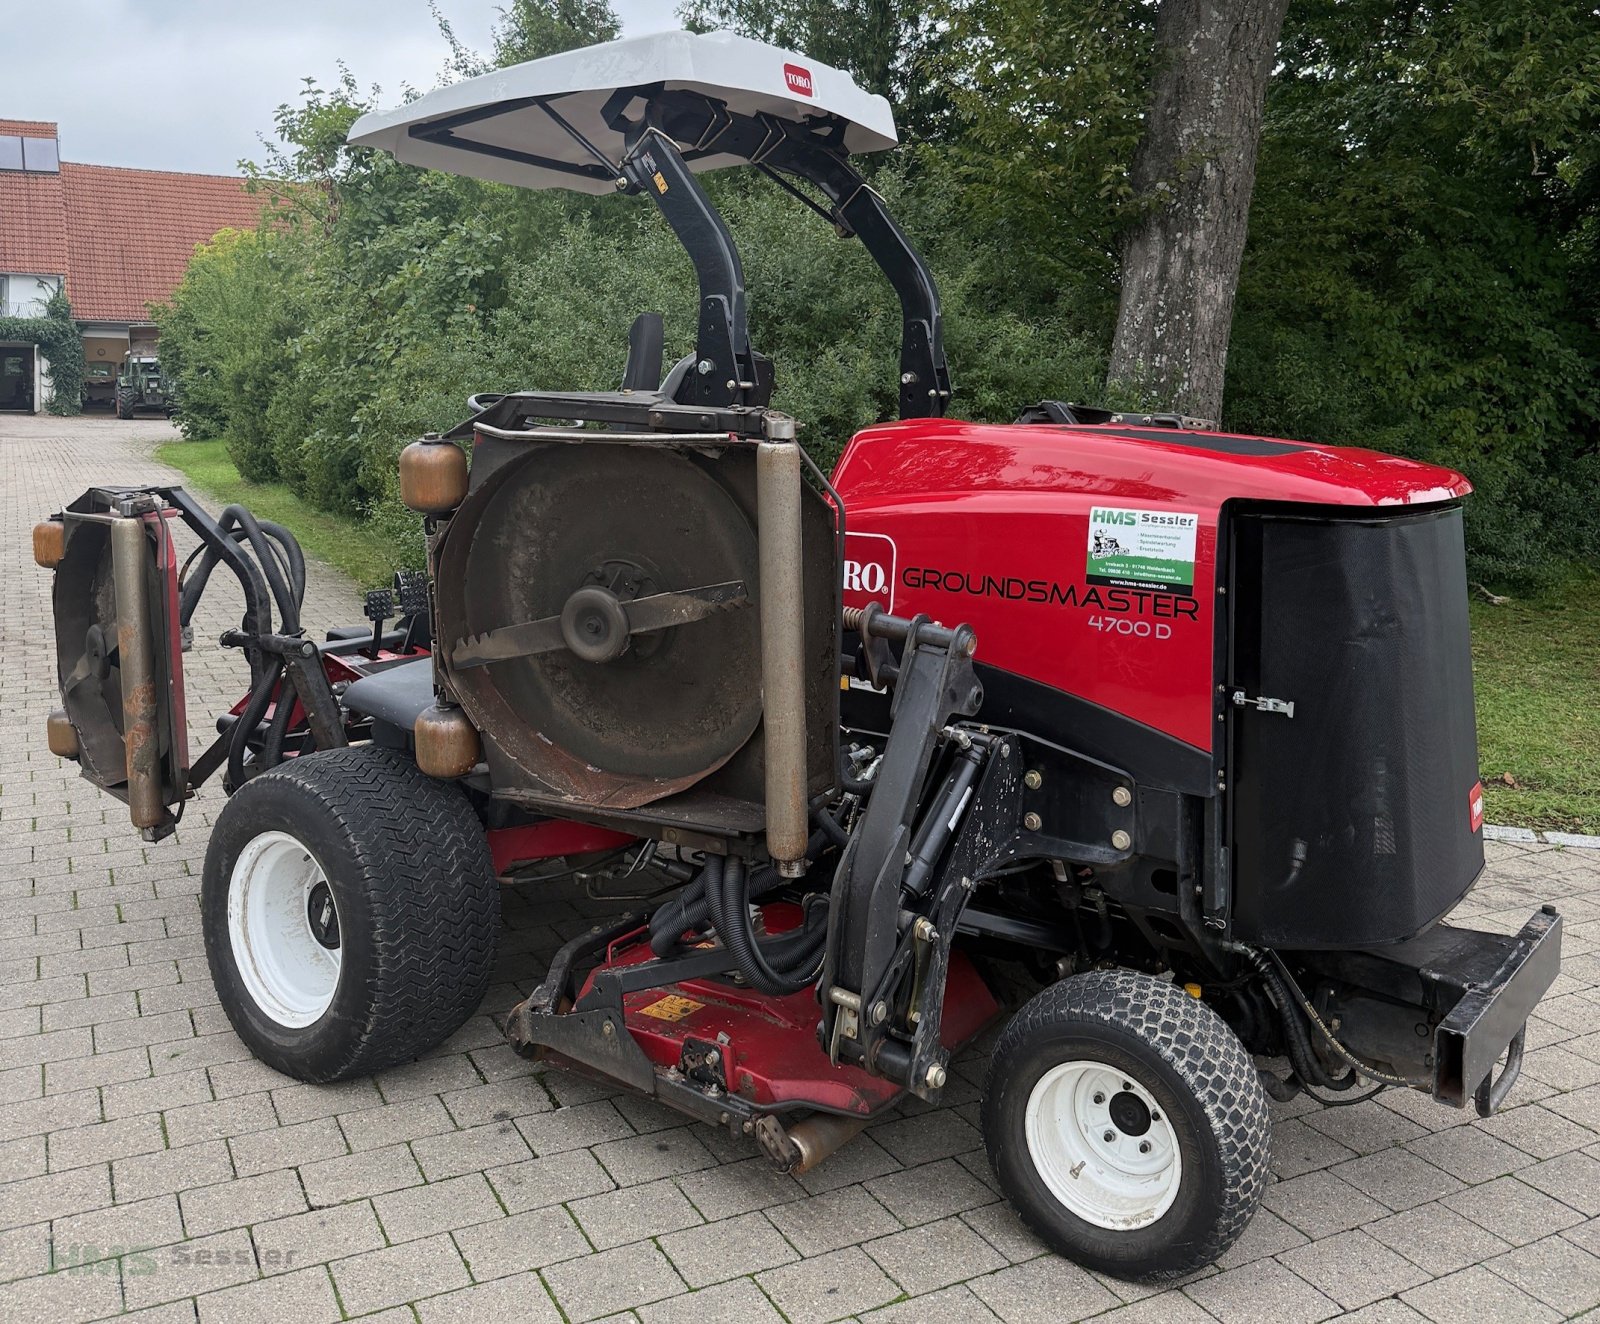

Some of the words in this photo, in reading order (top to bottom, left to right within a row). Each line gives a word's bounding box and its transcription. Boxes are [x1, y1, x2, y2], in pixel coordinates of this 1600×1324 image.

[1093, 509, 1136, 526] HMS
[1141, 513, 1194, 527] Sessler
[902, 567, 1200, 621] GROUNDSMASTER
[1110, 579, 1167, 590] www.hms-sessler.de
[1087, 615, 1151, 638] 4700
[1155, 623, 1173, 640] D
